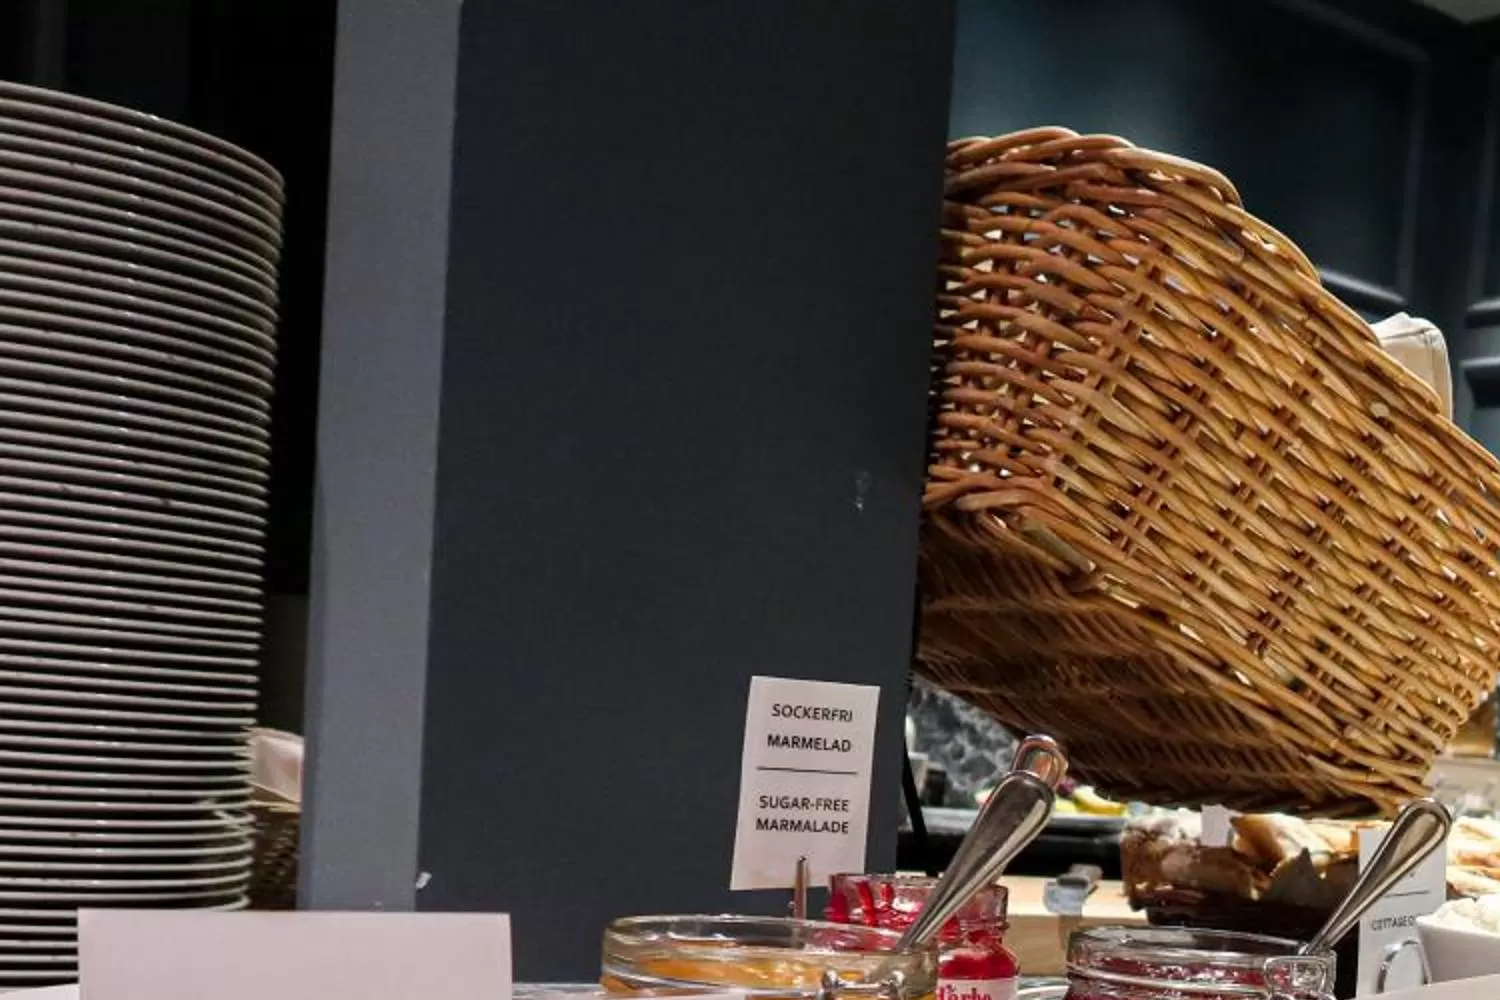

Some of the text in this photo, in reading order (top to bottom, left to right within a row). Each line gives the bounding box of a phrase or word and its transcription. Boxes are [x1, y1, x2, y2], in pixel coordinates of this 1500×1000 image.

[771, 703, 853, 722] SOCKERFRI
[767, 733, 852, 753] MARMELAD
[759, 795, 849, 812] SUGAR-FREE
[755, 817, 849, 834] MARMALADE
